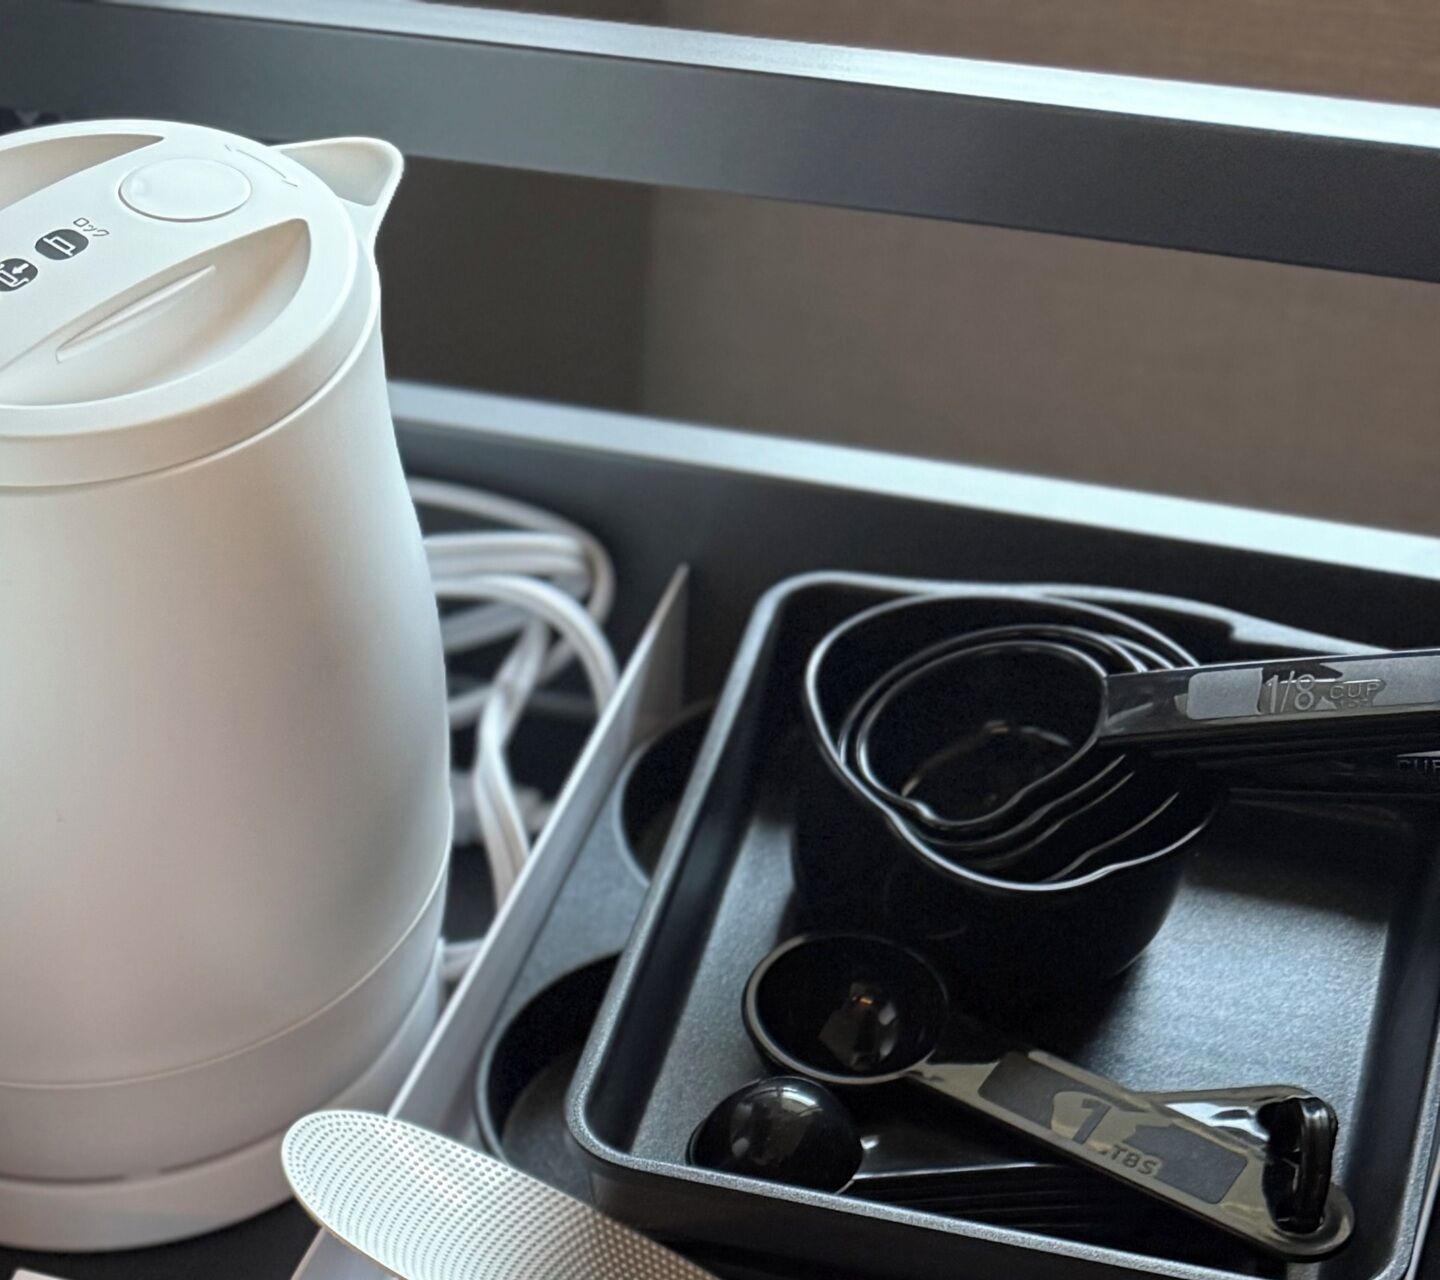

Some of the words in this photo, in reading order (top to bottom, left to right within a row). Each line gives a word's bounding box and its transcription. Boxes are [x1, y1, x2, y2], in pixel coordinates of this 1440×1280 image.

[72, 216, 110, 238] ロック
[1266, 670, 1317, 713] 1/8
[1329, 682, 1380, 701] CUP
[1110, 1143, 1158, 1175] TBS
